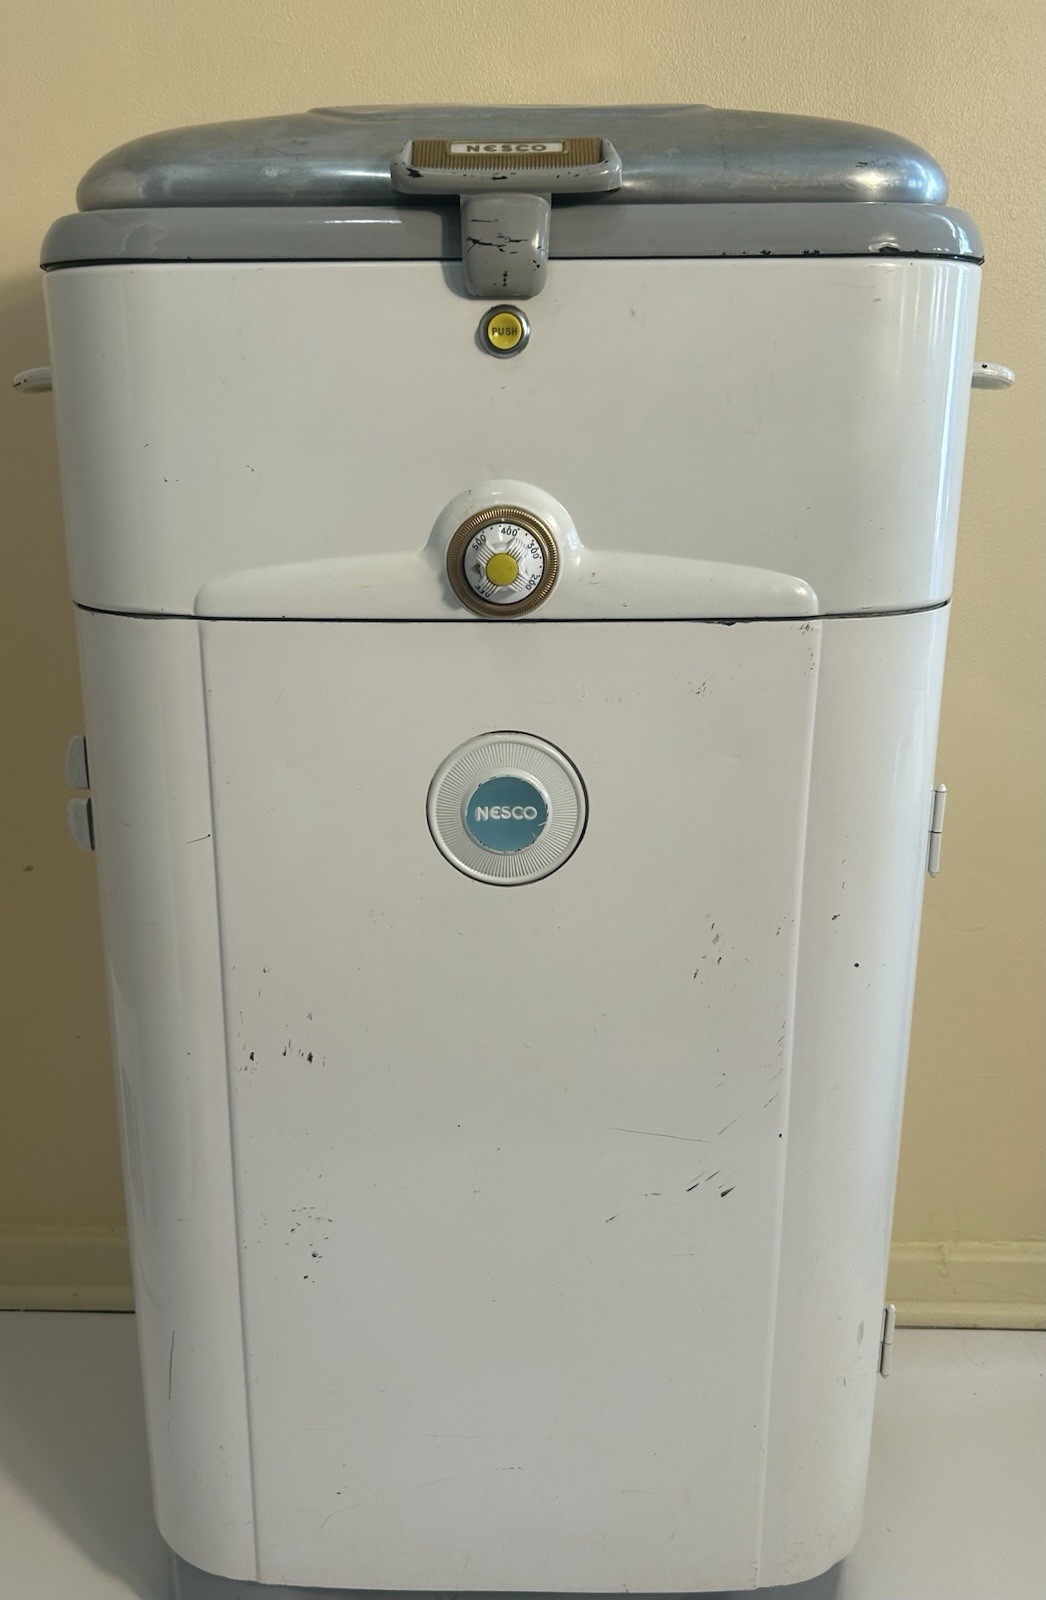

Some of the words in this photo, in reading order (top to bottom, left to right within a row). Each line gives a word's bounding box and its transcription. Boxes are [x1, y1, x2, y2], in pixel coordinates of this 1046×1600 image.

[466, 144, 546, 152] NESCO
[491, 327, 517, 336] PUSH
[501, 527, 518, 537] 400
[472, 535, 487, 551] 500
[527, 543, 540, 560] 300
[525, 574, 540, 591] 200
[476, 806, 538, 822] NESCO
